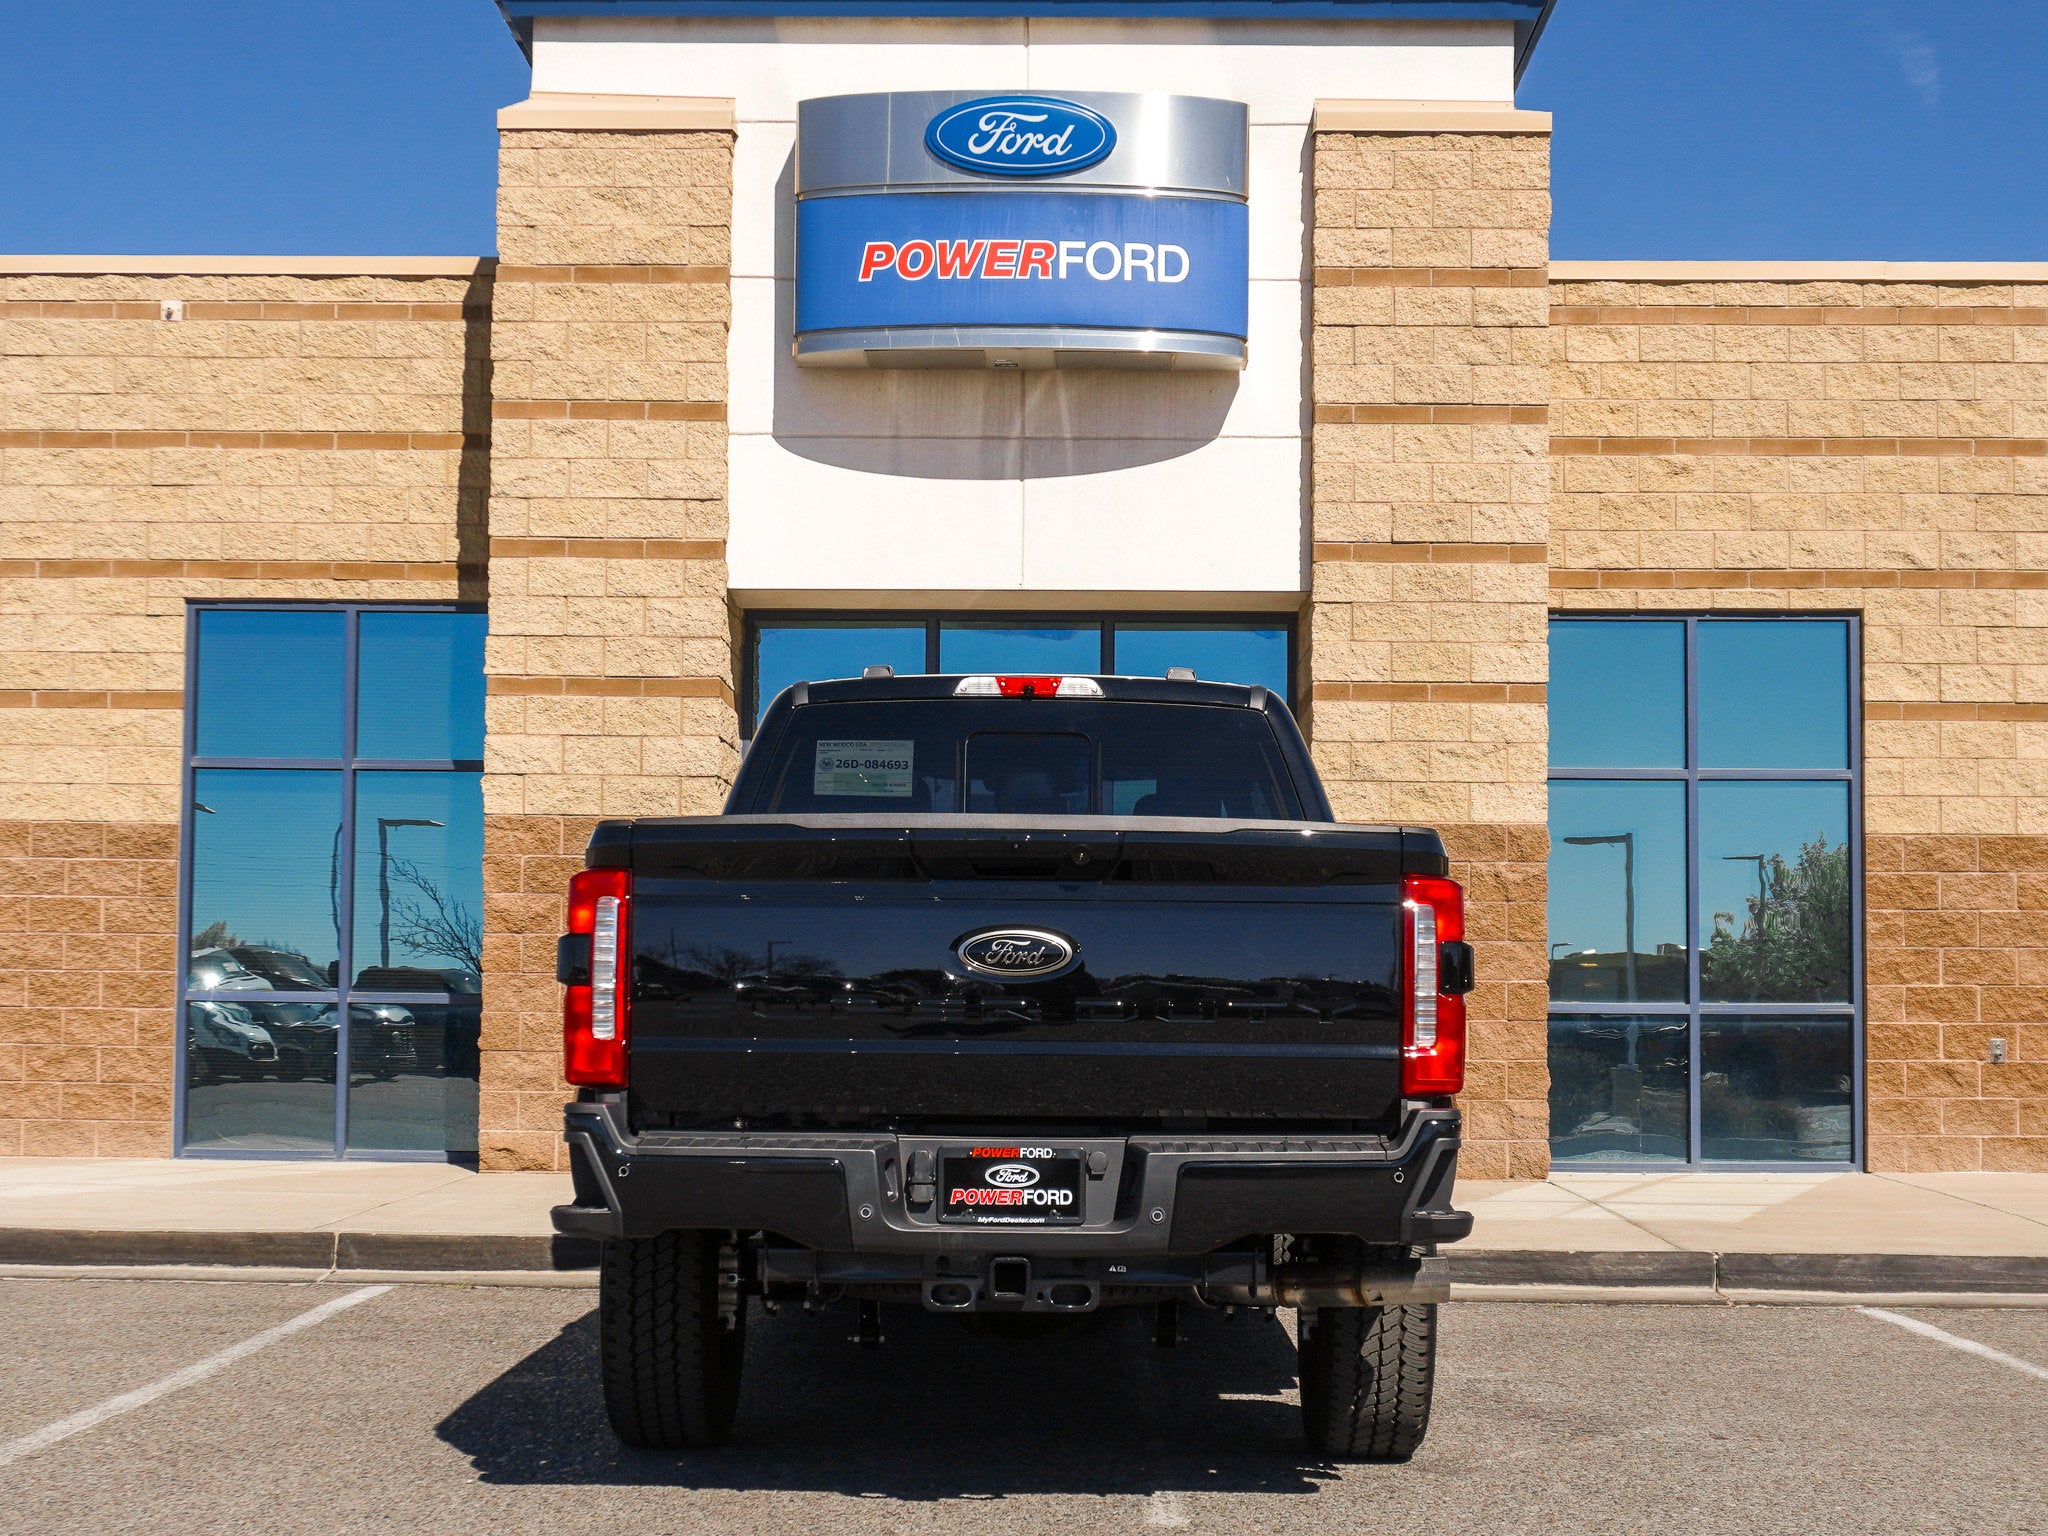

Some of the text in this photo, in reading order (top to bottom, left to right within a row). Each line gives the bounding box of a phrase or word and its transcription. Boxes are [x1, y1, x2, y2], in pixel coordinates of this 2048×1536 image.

[968, 111, 1075, 156] Ford
[858, 239, 1191, 283] POWERFORD
[835, 759, 909, 769] 26D-084693
[985, 939, 1045, 965] Ford
[972, 1147, 1053, 1158] POWERFORD
[995, 1168, 1030, 1184] Ford
[950, 1188, 1073, 1206] POWERFORD
